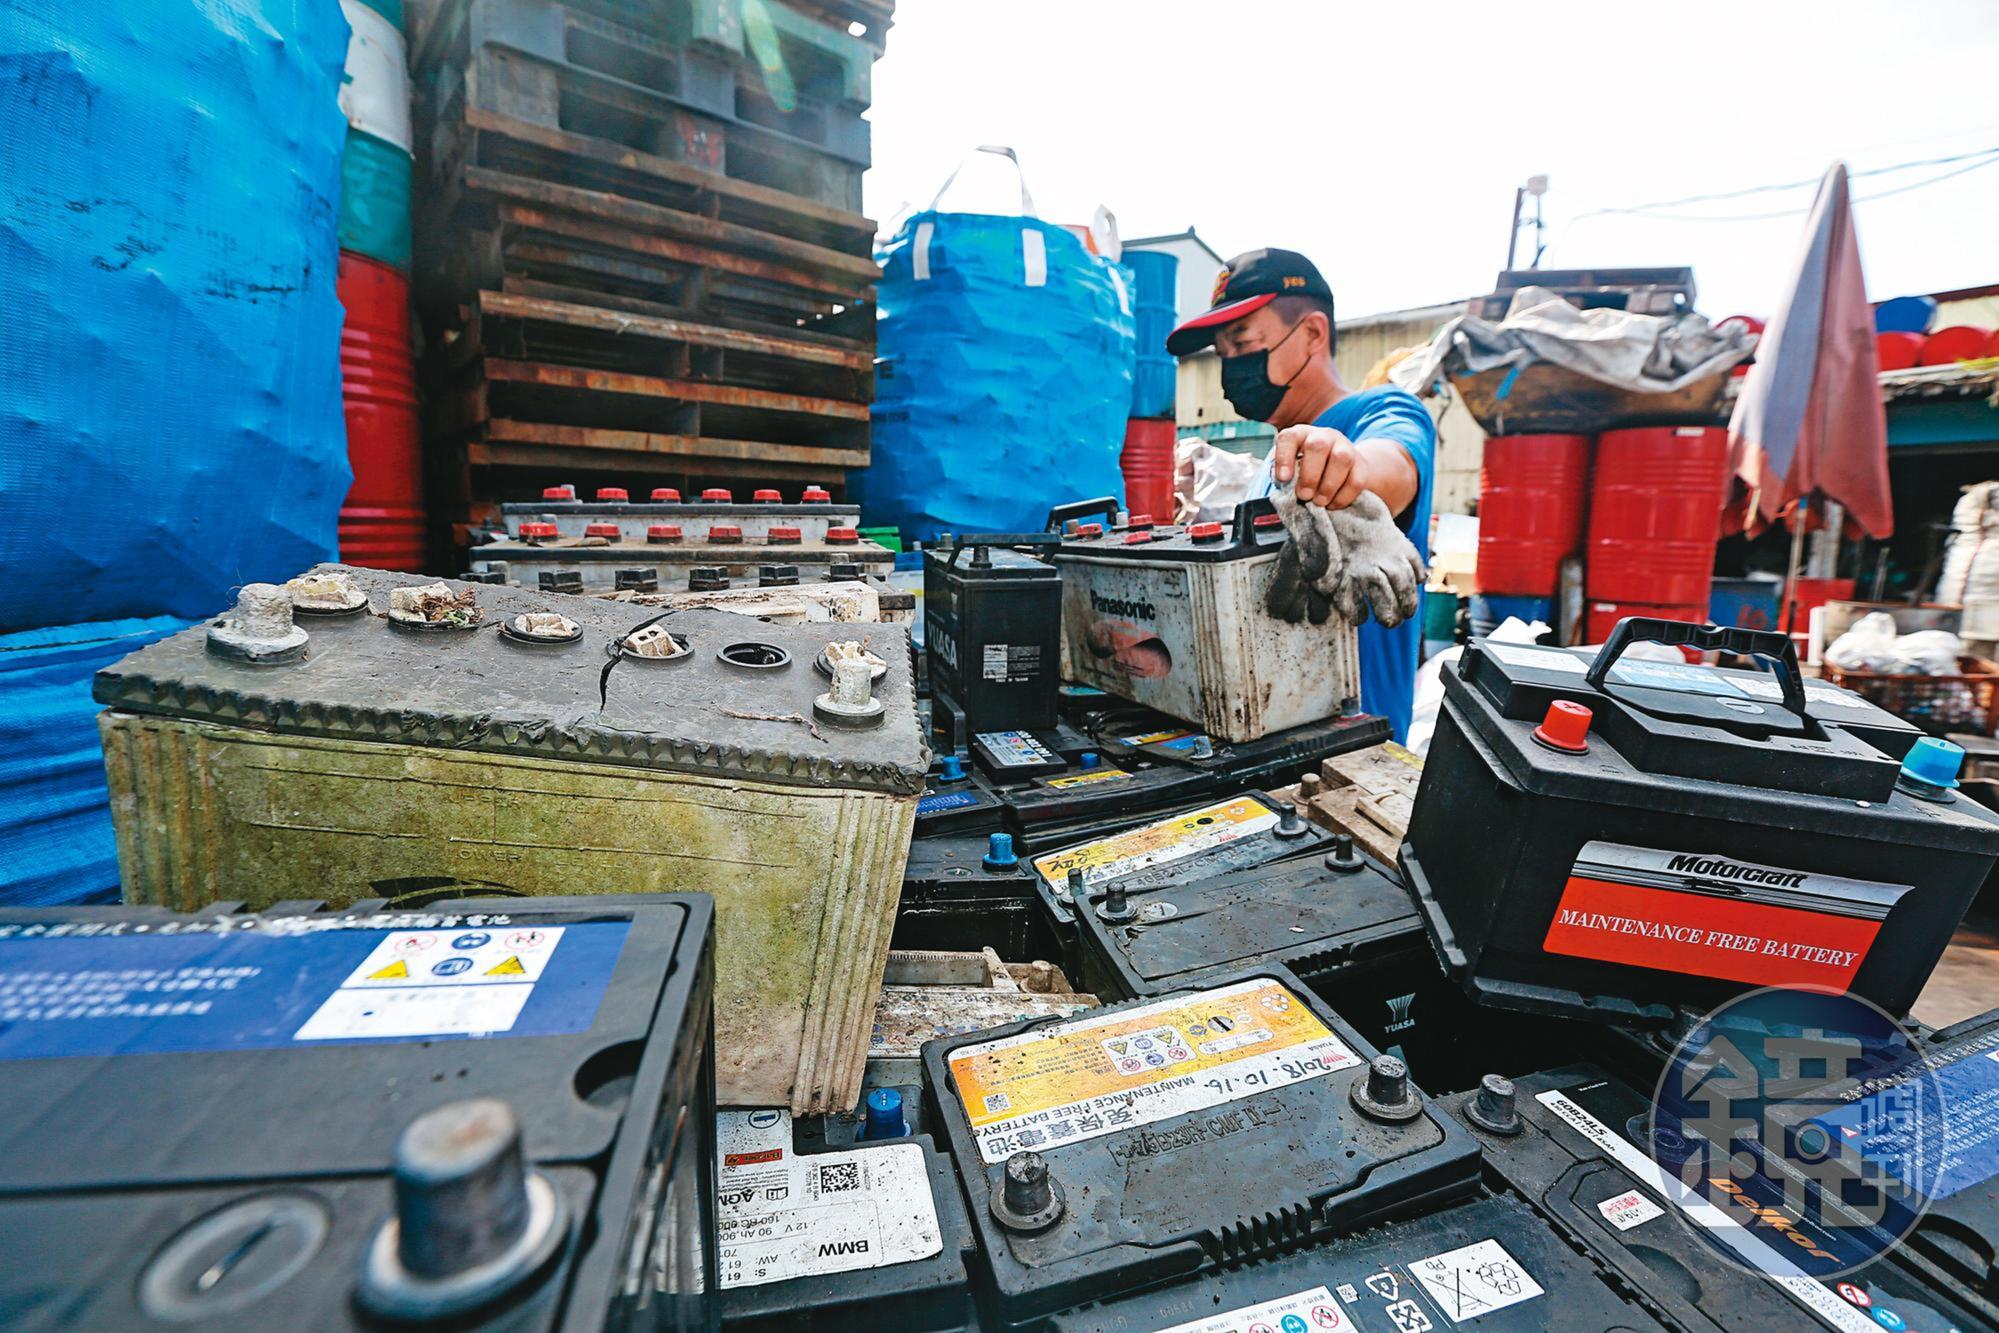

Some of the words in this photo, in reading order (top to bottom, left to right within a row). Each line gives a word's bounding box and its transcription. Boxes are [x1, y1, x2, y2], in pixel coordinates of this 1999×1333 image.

[1090, 589, 1156, 621] Panasonic
[927, 620, 958, 671] YUASA
[1667, 854, 1809, 889] Motorcraft
[1558, 908, 1703, 945] MAINTENANCE
[1704, 930, 1759, 952] FREE
[1760, 939, 1859, 968] BATTERY
[1384, 1018, 1416, 1034] YUASA
[1096, 1075, 1196, 1110] MAINTENANCE
[1054, 1103, 1097, 1119] FREE
[1556, 1098, 1608, 1136] 60B24LS
[982, 1112, 1050, 1137] BATTERY
[986, 1105, 1133, 1156] 免保養電池
[784, 1224, 793, 1233] V
[796, 1222, 809, 1230] 12
[1708, 1178, 1841, 1263] Delkor
[759, 1228, 773, 1237] 90
[818, 1239, 870, 1257] BMW
[755, 1254, 779, 1266] AW:
[1425, 1258, 1447, 1271] Pb
[754, 1268, 766, 1278] S:
